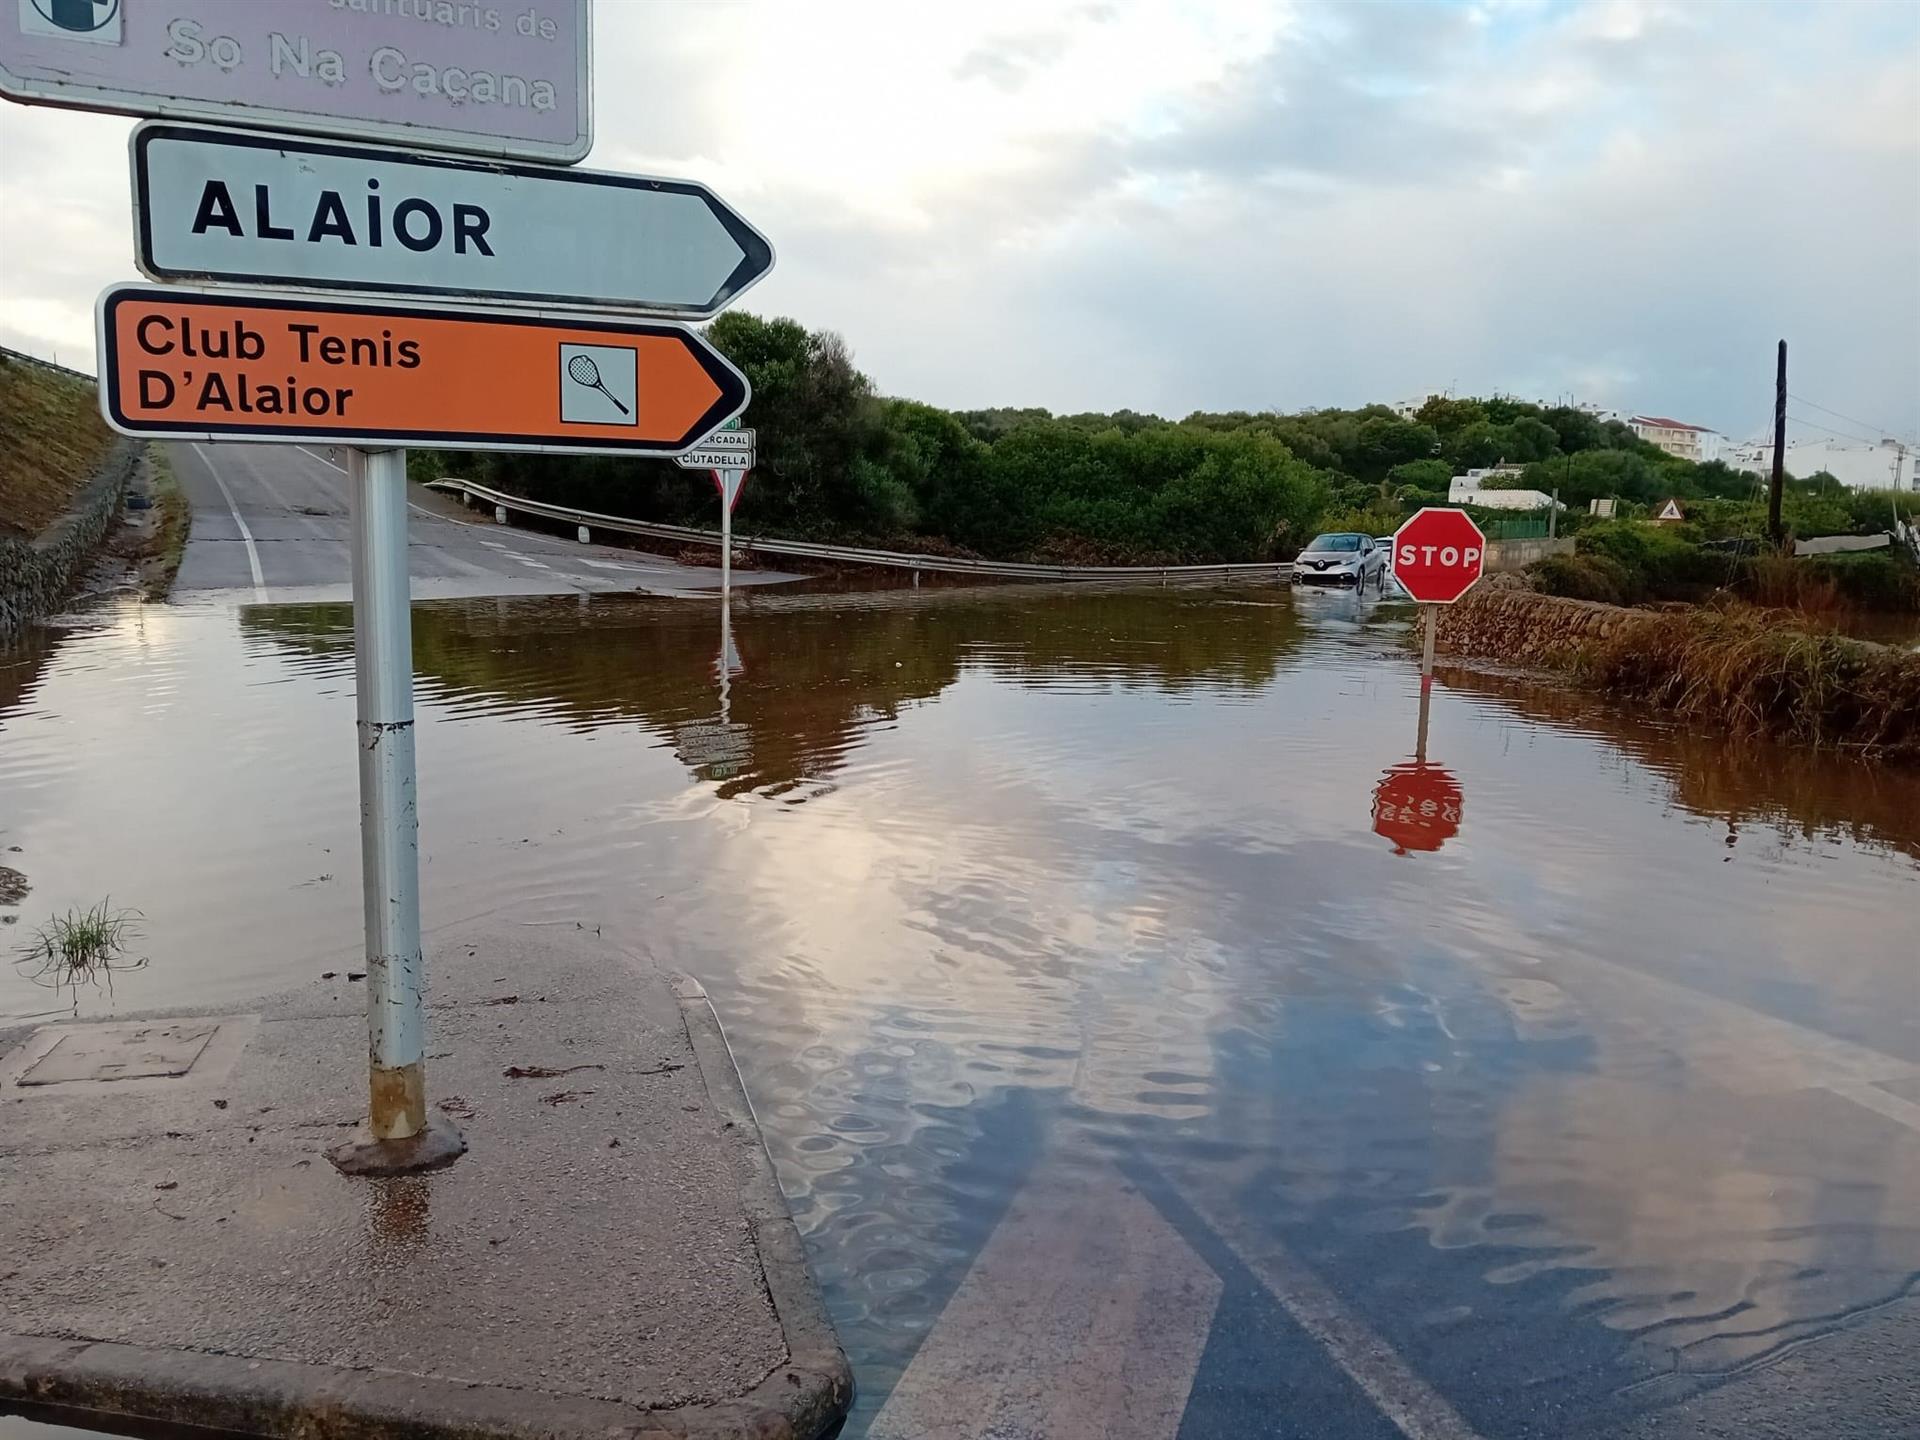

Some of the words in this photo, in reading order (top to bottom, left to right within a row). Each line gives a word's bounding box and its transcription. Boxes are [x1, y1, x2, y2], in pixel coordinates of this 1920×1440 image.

[516, 9, 558, 40] de
[165, 18, 242, 69] So
[269, 32, 346, 83] Na
[369, 46, 558, 111] Caçana
[136, 314, 266, 360] Club
[287, 323, 422, 369] Tenis
[1399, 545, 1479, 567] STOP
